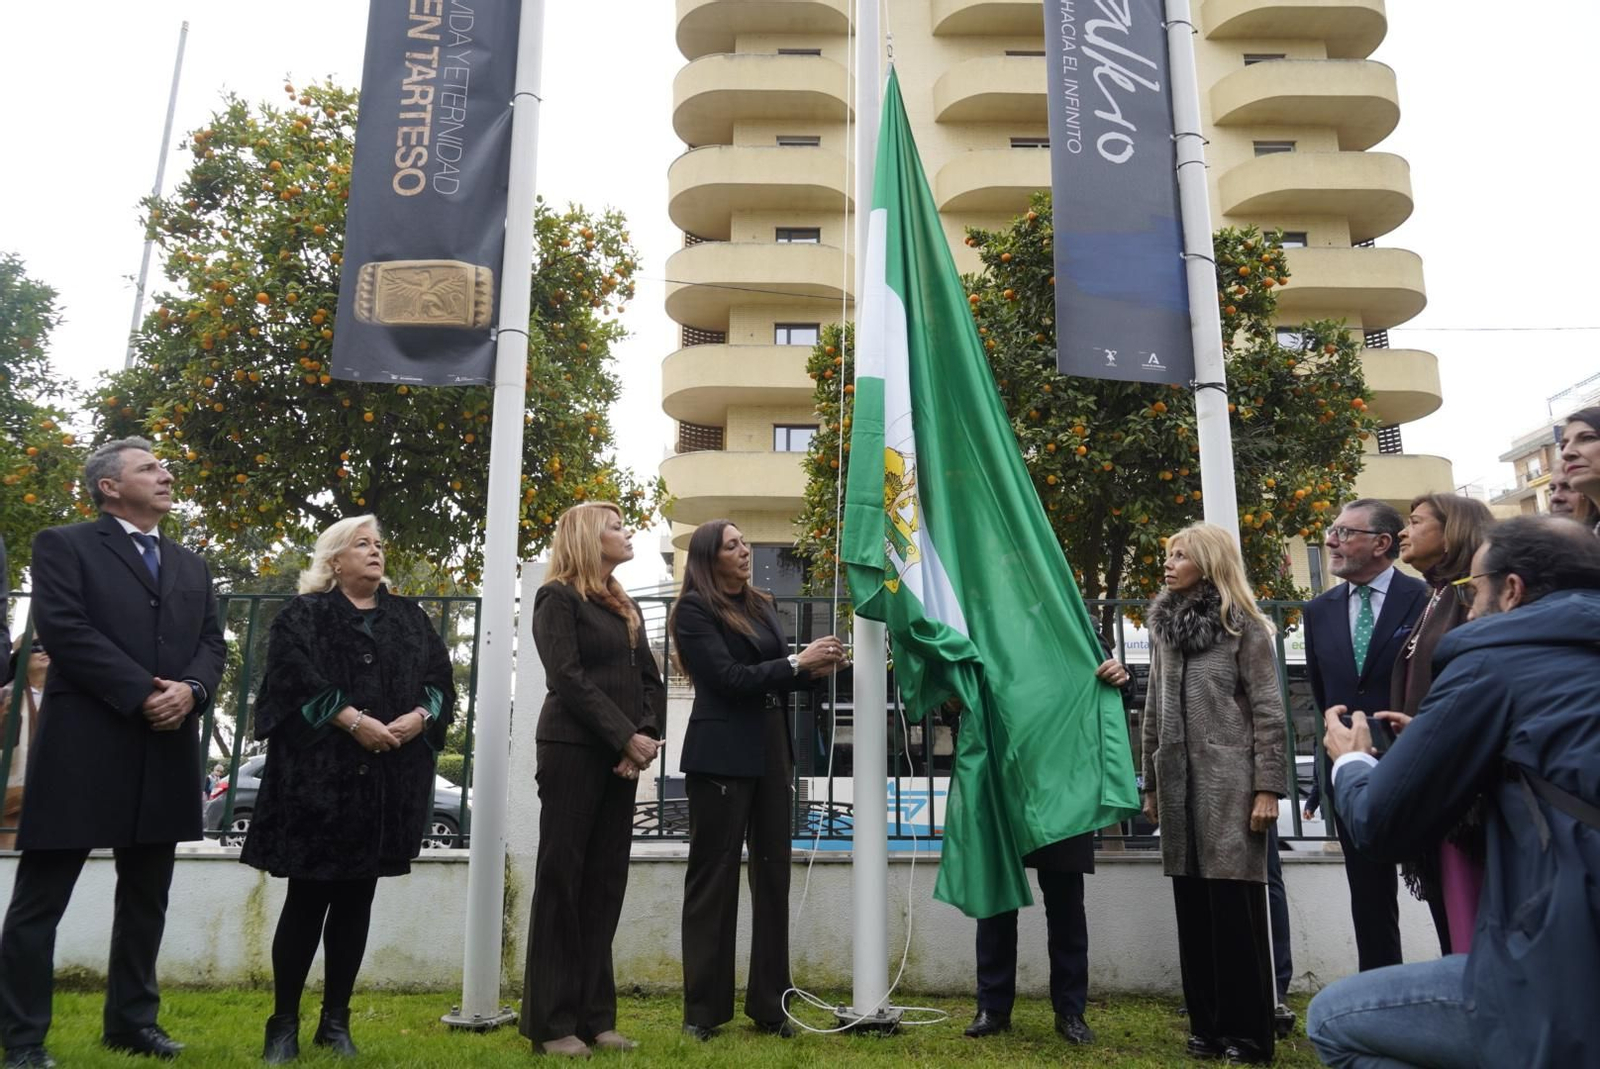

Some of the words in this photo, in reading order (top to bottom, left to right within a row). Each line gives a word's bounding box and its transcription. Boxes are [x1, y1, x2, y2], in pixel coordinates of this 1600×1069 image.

[407, 0, 443, 40] EN
[1060, 0, 1076, 51] HACIA
[446, 50, 472, 65] Y
[1062, 55, 1078, 74] EL
[392, 46, 439, 197] TARTESO
[433, 66, 470, 195] ETERNIDAD
[1064, 78, 1082, 154] INFINITO
